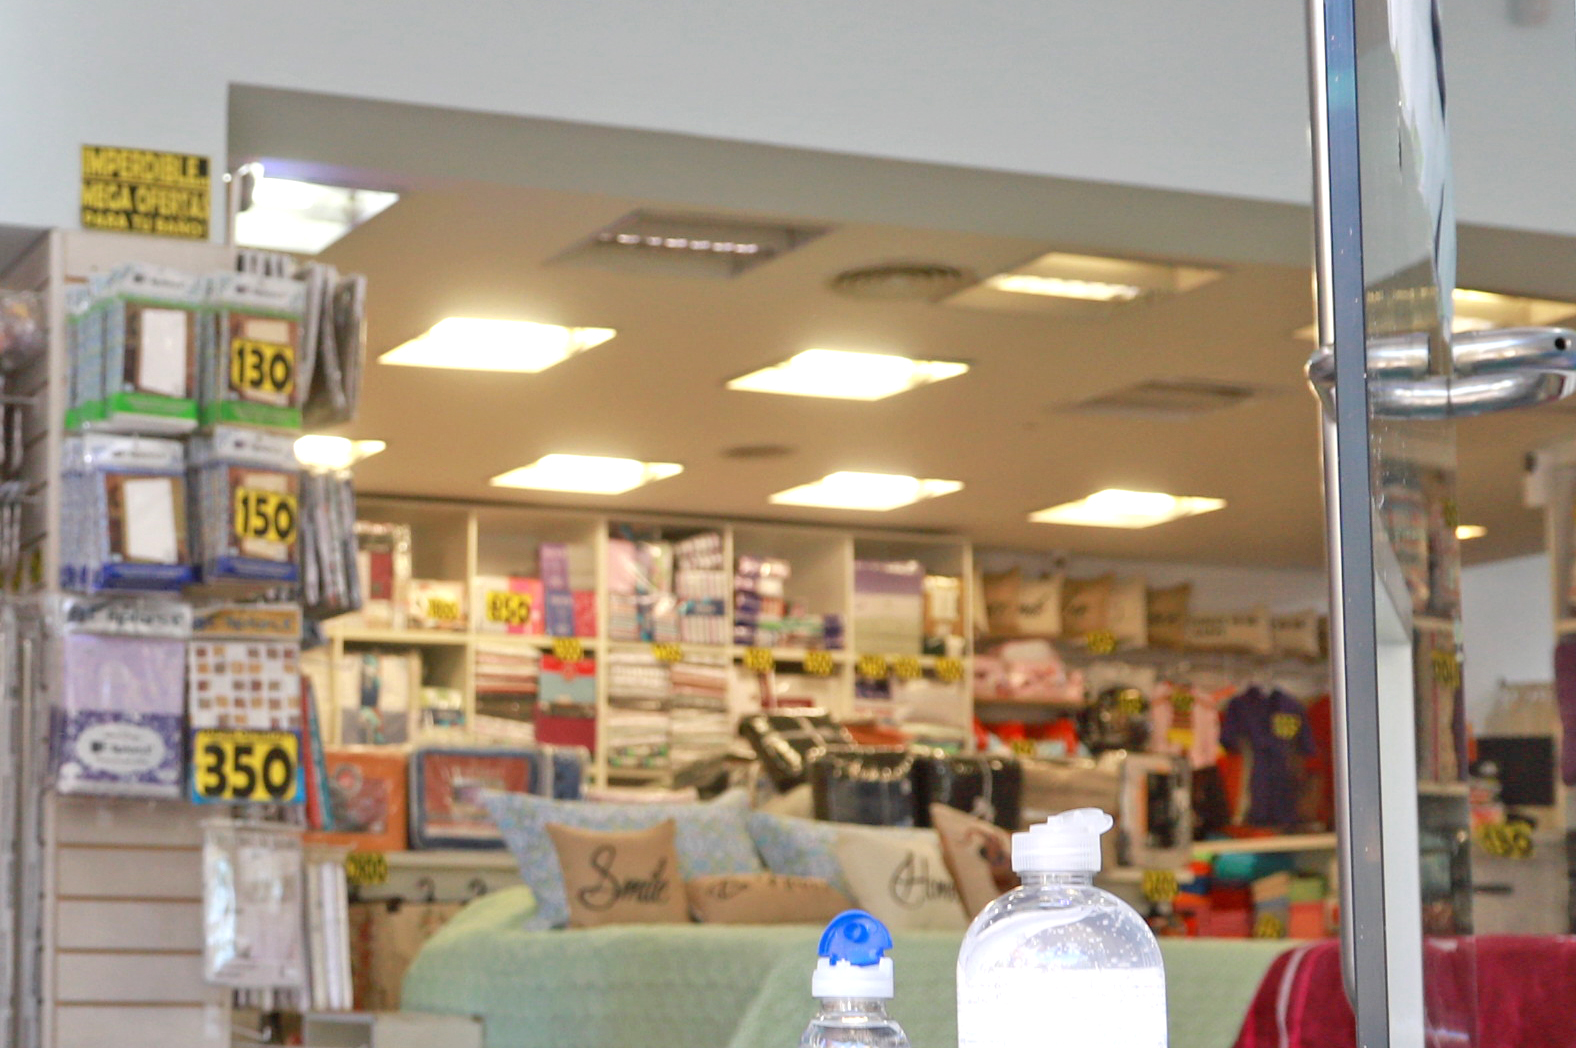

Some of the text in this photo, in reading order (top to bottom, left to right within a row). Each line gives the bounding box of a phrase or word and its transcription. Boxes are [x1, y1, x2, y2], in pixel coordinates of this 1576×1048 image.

[236, 344, 291, 391] 130
[241, 496, 294, 539] 150
[203, 742, 293, 799] 350
